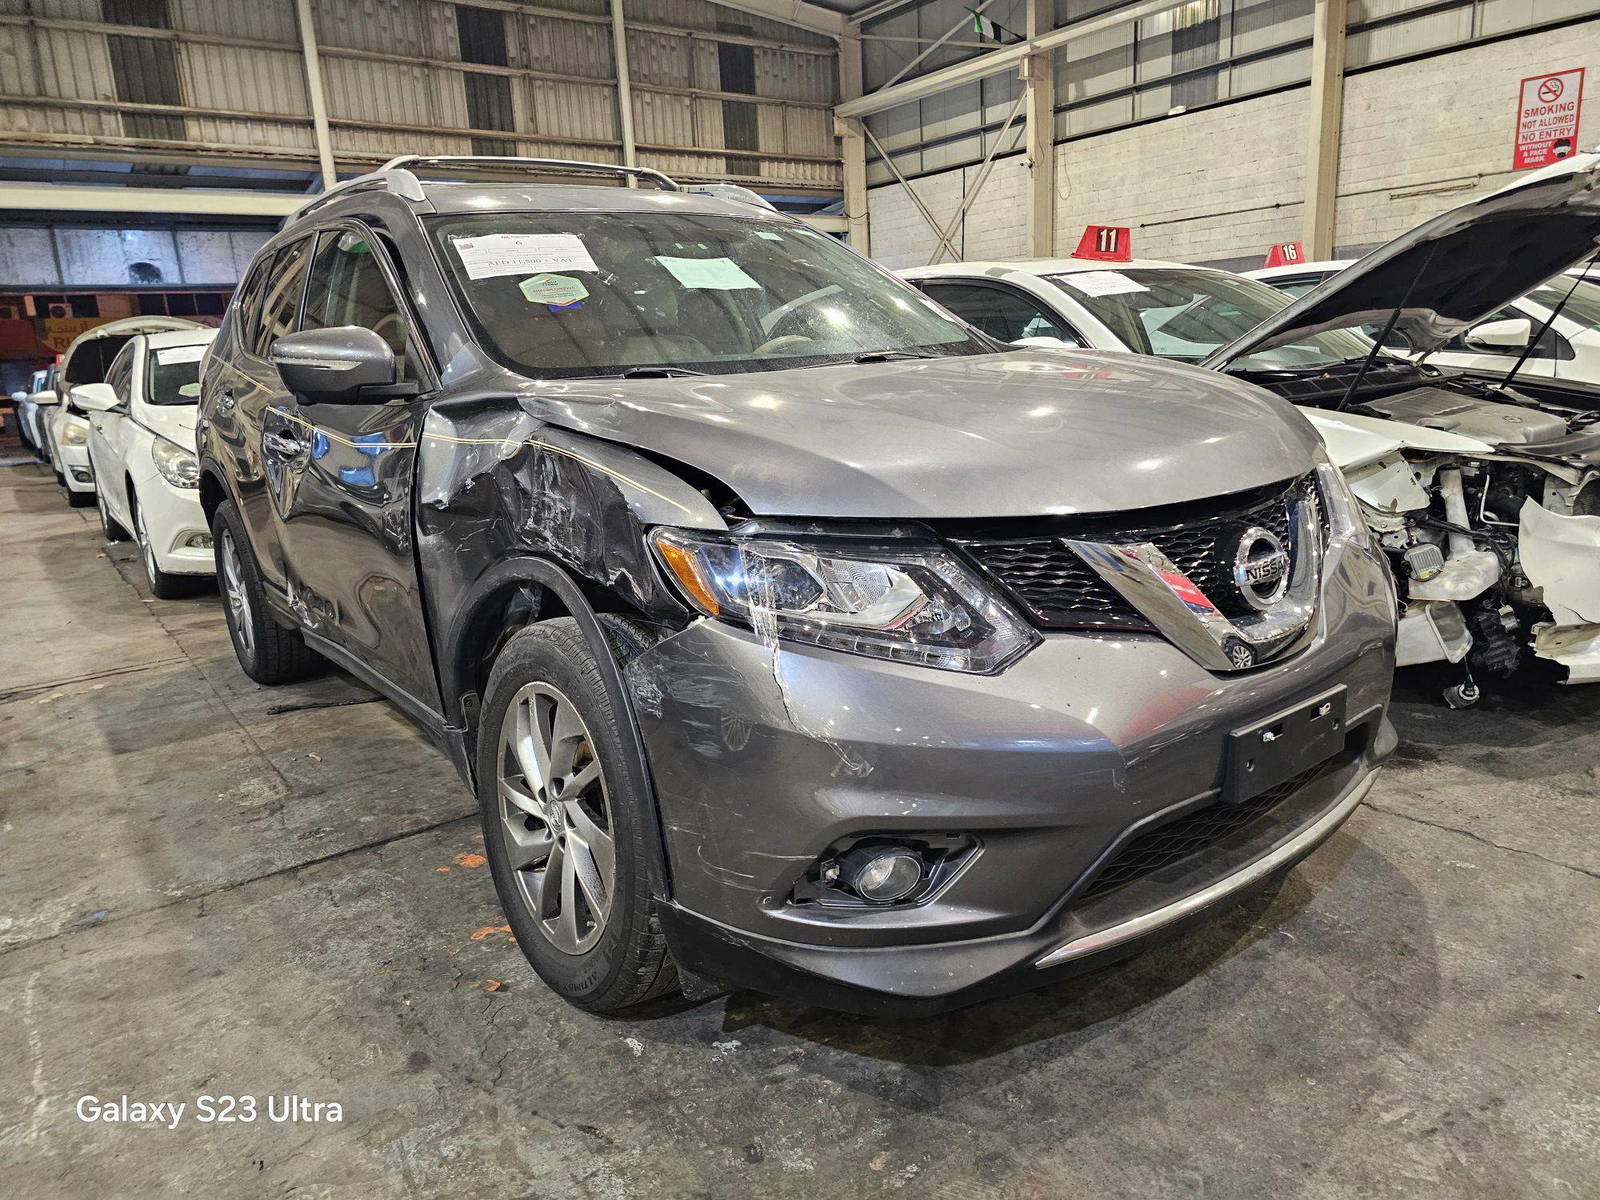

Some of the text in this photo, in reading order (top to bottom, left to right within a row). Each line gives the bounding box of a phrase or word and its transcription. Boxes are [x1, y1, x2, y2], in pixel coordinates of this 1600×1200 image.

[1524, 102, 1575, 118] SMOKING
[1522, 114, 1575, 130] NOT ALLOWED
[1522, 127, 1572, 142] NO ENTRY
[1520, 142, 1552, 151] WITHOUT
[1100, 229, 1117, 252] 11
[1283, 245, 1297, 260] 16
[1245, 556, 1289, 581] NISSAN
